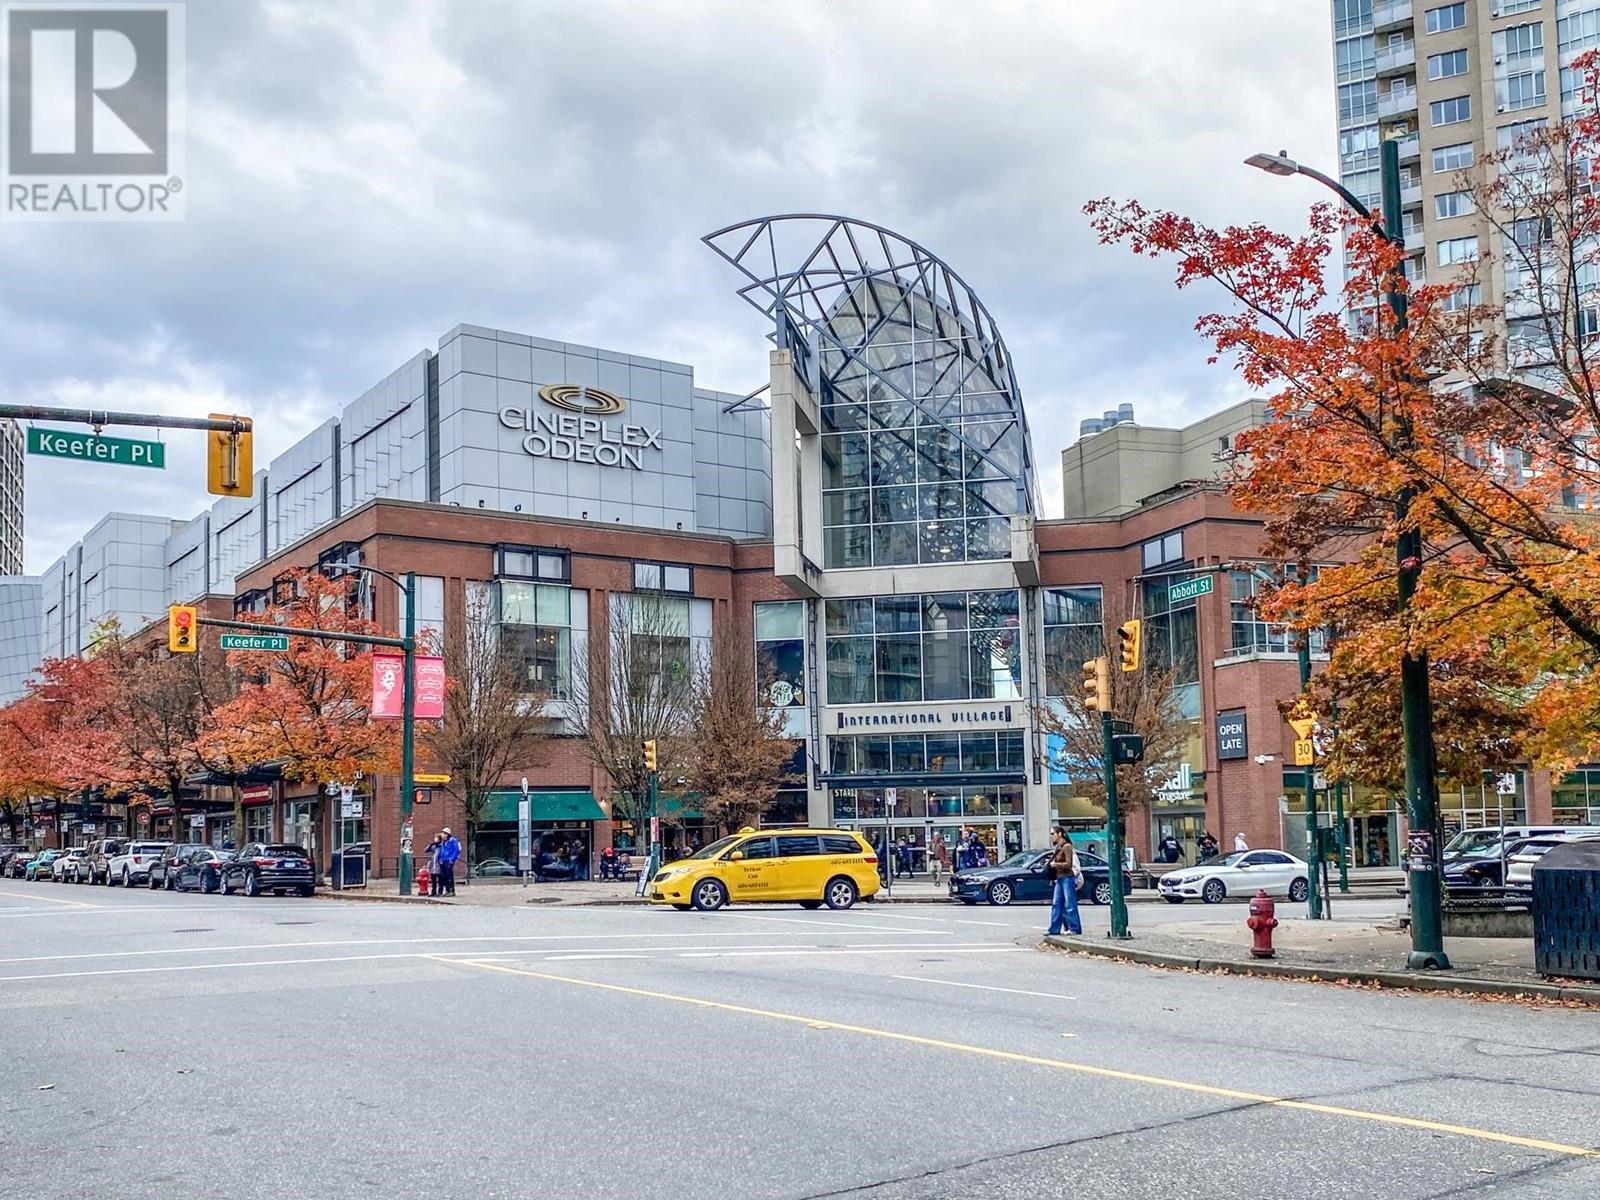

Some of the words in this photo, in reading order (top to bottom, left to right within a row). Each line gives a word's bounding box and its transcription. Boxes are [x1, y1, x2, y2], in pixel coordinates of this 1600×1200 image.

[499, 405, 663, 450] CINEPLEX
[40, 433, 119, 459] Keefer
[131, 444, 153, 463] Pl
[522, 434, 643, 470] ODEON
[1171, 583, 1198, 600] Abbott
[1200, 579, 1210, 592] St
[227, 637, 267, 648] Keefer
[271, 639, 282, 649] Pl
[845, 713, 943, 727] INTERNATIONAL
[951, 711, 1004, 723] VILLAGE
[1219, 723, 1243, 736] OPEN
[1221, 738, 1243, 750] LATE
[1298, 743, 1310, 756] 30
